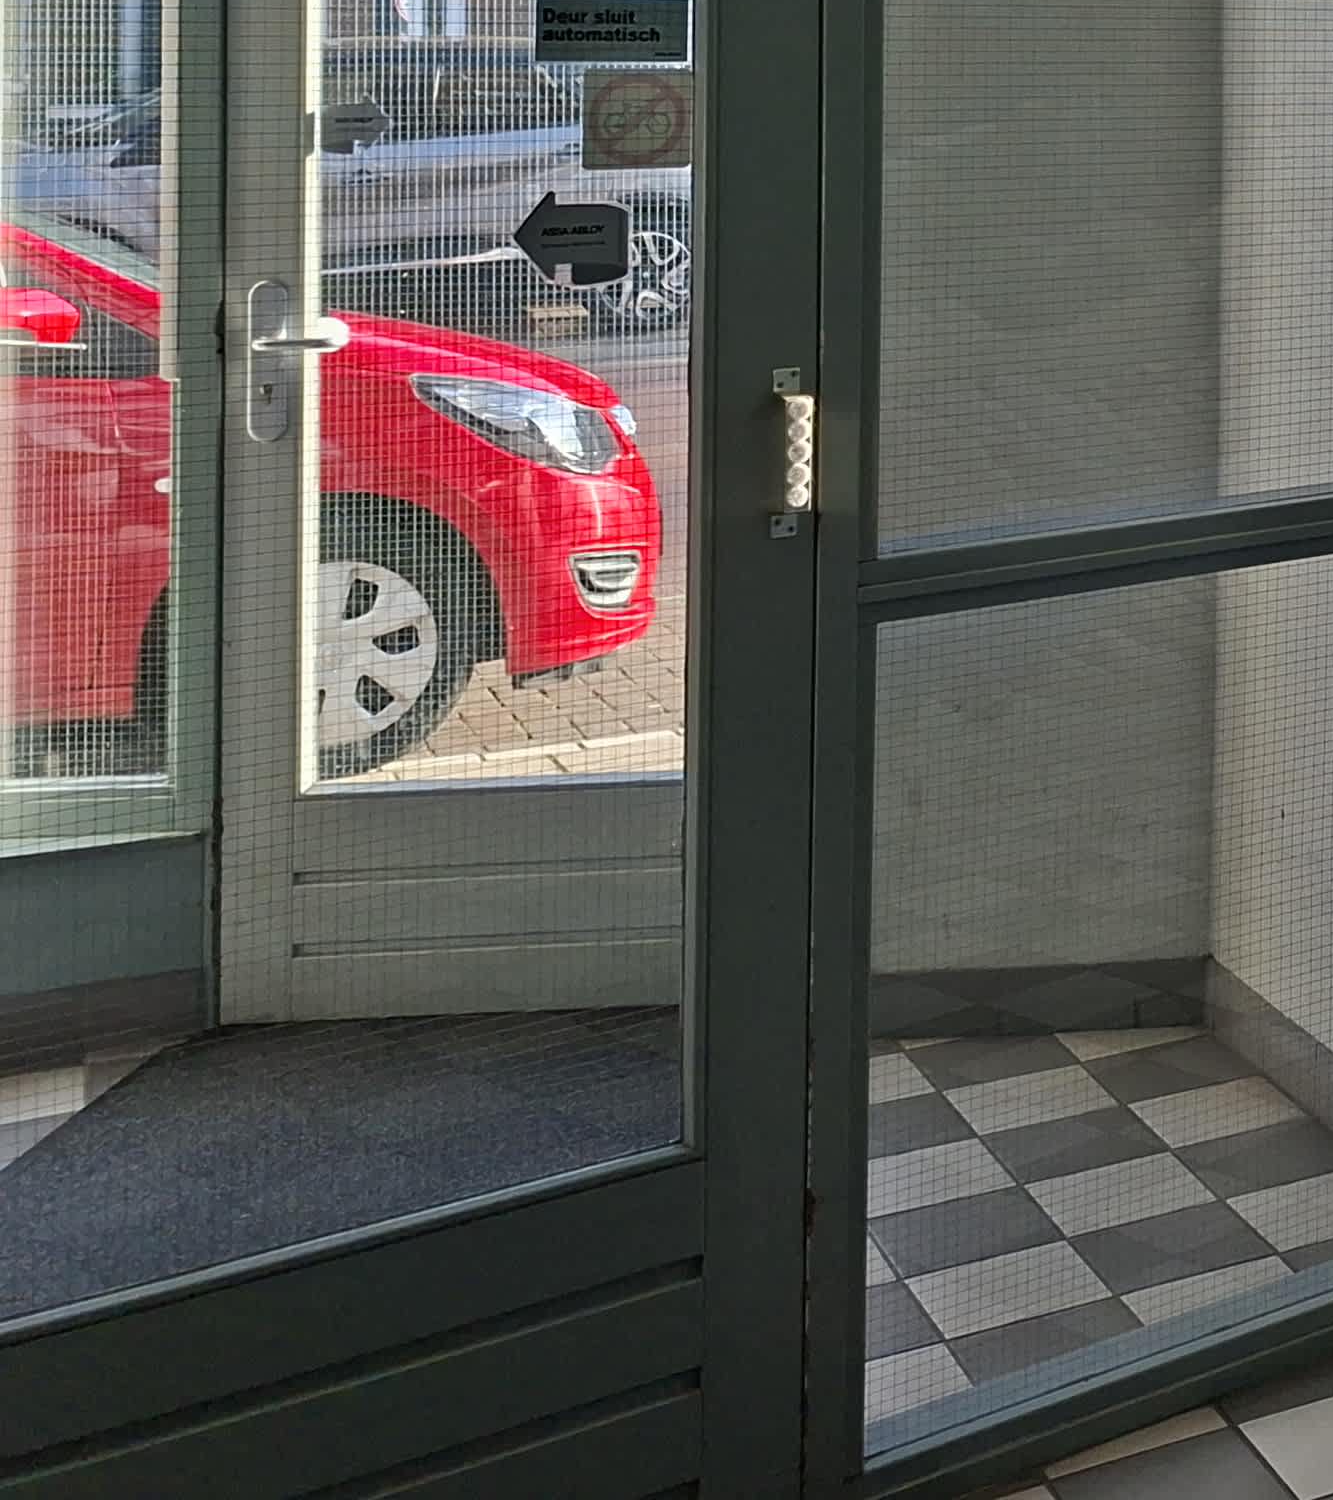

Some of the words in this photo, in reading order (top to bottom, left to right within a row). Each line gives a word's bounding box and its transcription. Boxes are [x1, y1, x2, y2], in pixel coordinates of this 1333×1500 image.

[543, 8, 588, 24] Deur
[593, 10, 636, 24] sluit
[542, 27, 660, 42] automatisch
[570, 225, 605, 235] ABLOY
